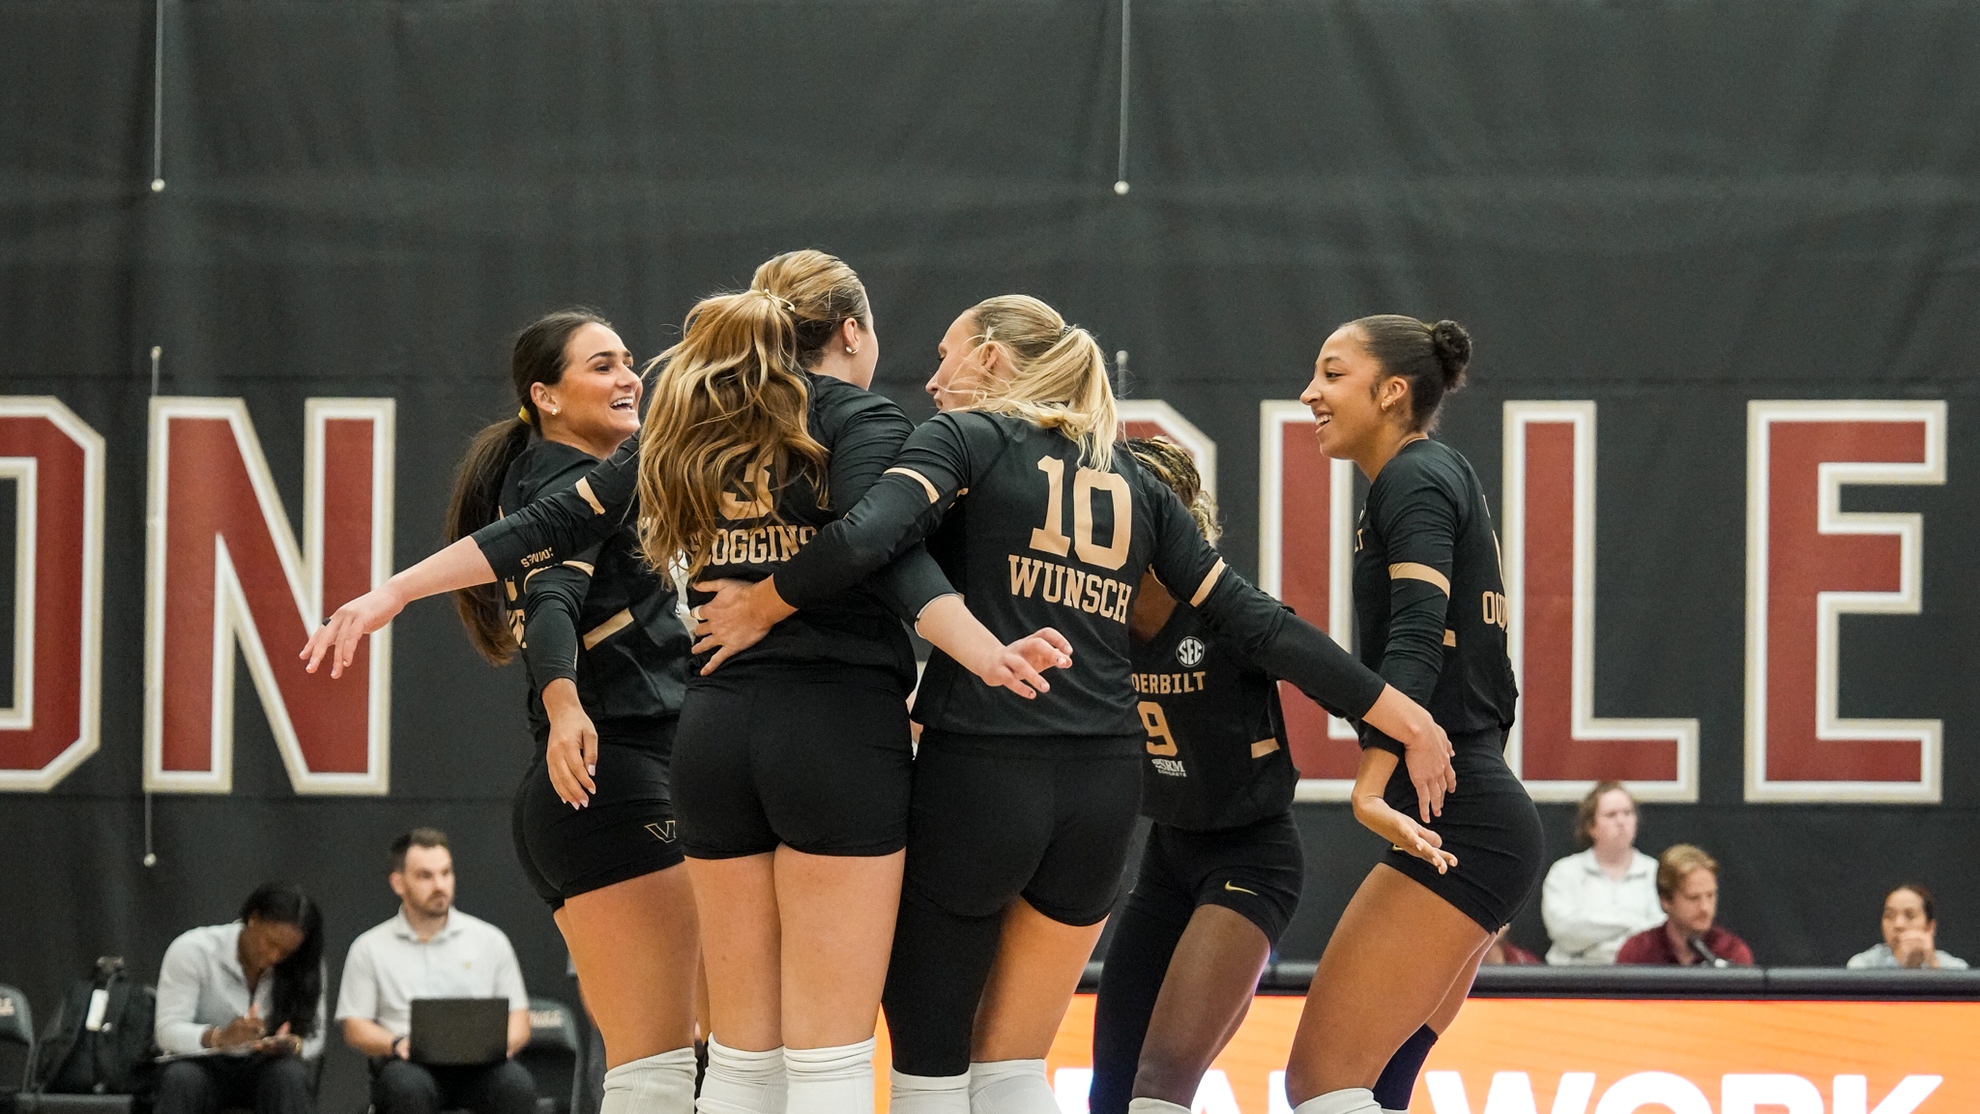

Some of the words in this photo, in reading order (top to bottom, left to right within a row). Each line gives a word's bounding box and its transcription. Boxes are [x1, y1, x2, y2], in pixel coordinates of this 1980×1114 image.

[1029, 455, 1132, 571] 10
[1008, 554, 1132, 624] WUNSCH
[1178, 639, 1203, 665] SEC
[1137, 701, 1178, 757] 9
